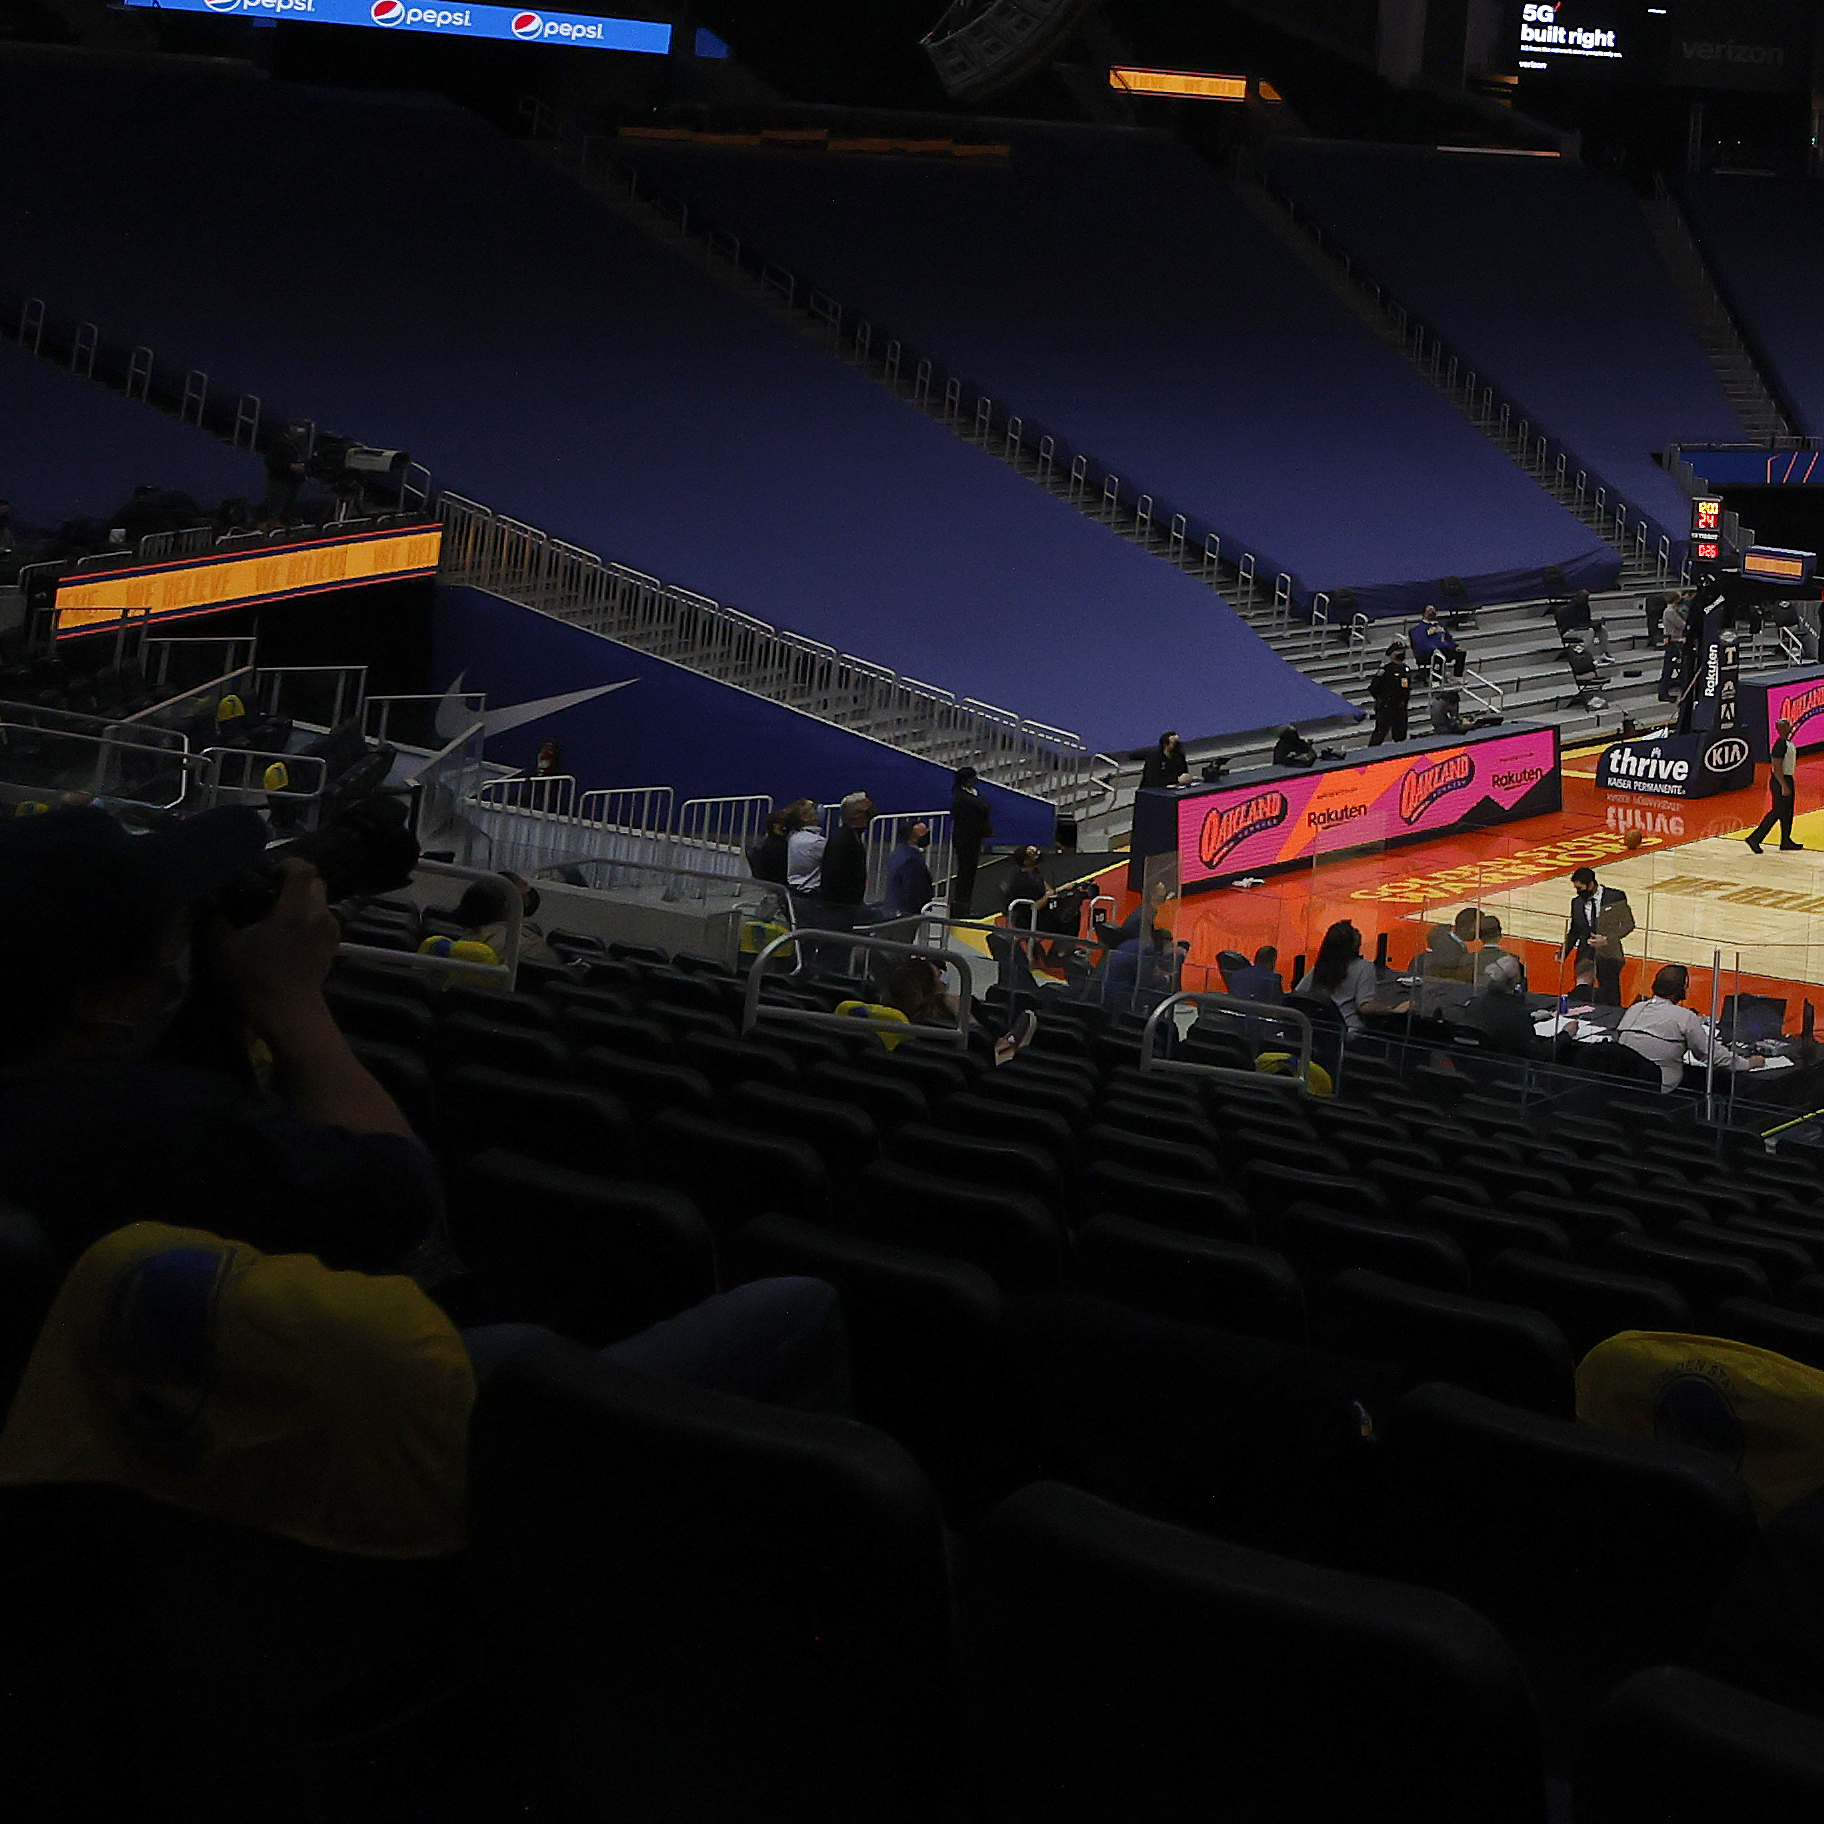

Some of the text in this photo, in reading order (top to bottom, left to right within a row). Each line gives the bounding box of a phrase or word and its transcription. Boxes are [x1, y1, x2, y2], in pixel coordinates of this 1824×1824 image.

[407, 5, 471, 30] pepsi
[1523, 3, 1554, 23] 5G
[544, 19, 603, 41] pepsi
[1521, 24, 1615, 48] built right
[1519, 61, 1547, 69] verizon
[1705, 644, 1718, 696] Rakuten
[1610, 747, 1689, 780] thrive
[1712, 745, 1740, 766] KIA
[1492, 766, 1542, 789] Rakuten
[1608, 778, 1683, 795] KAISER PERMANENTE
[1308, 804, 1367, 828] Rakuten
